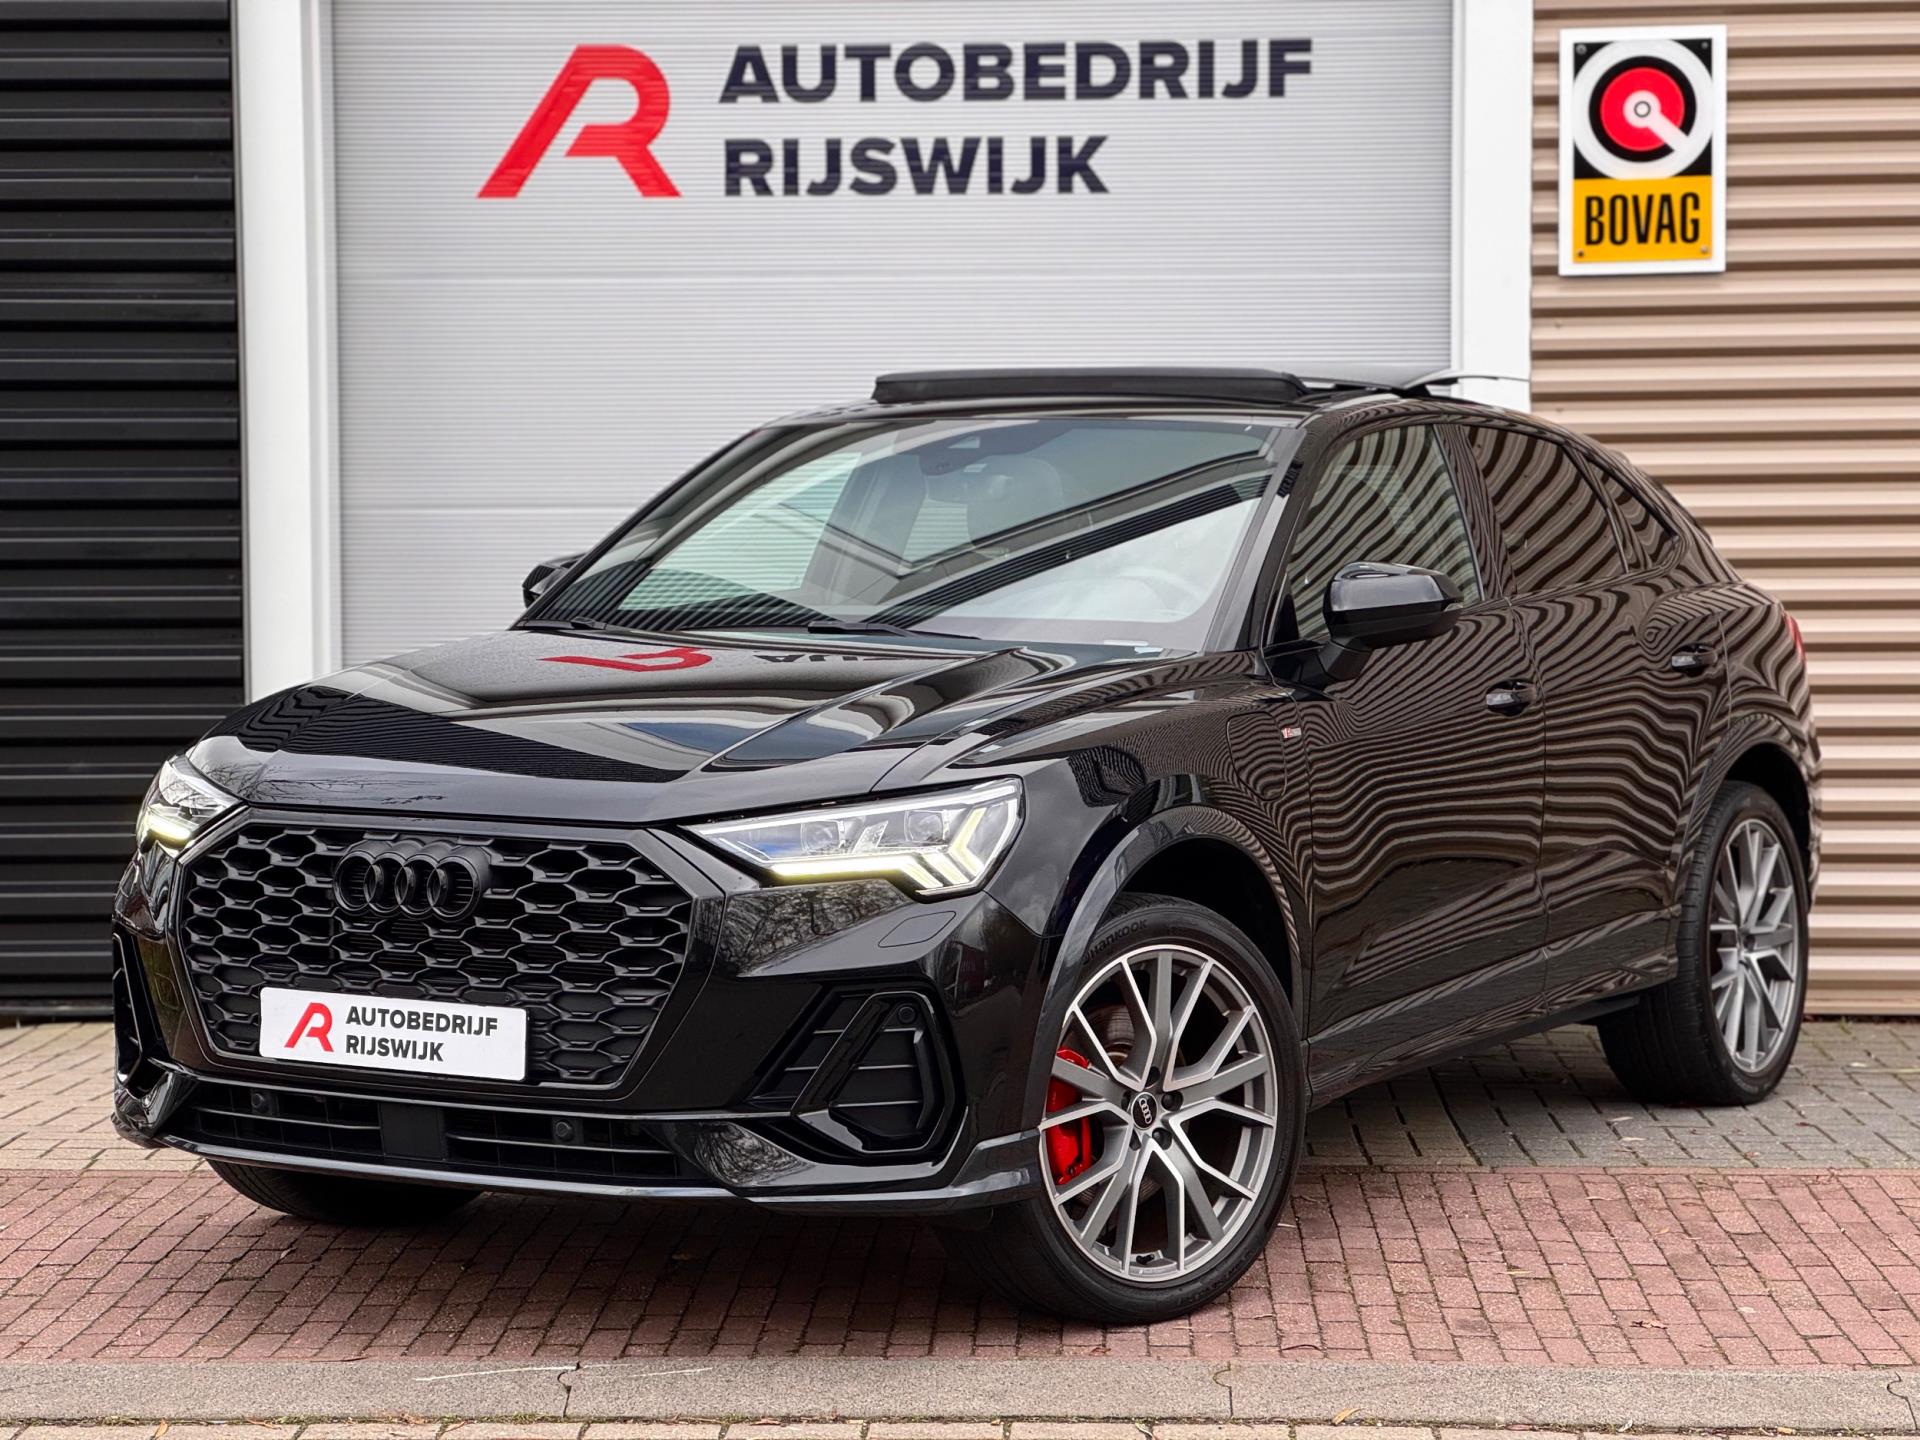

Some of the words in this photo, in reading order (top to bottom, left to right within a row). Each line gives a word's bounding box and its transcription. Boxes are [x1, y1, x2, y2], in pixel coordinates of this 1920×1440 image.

[719, 39, 1312, 104] AUTOBEDRIJF
[724, 135, 1108, 196] RIJSWIJK
[1585, 192, 1700, 246] BOVAG
[345, 1006, 499, 1036] AUTOBEDRIJF
[345, 1034, 445, 1062] RIJSWIJK
